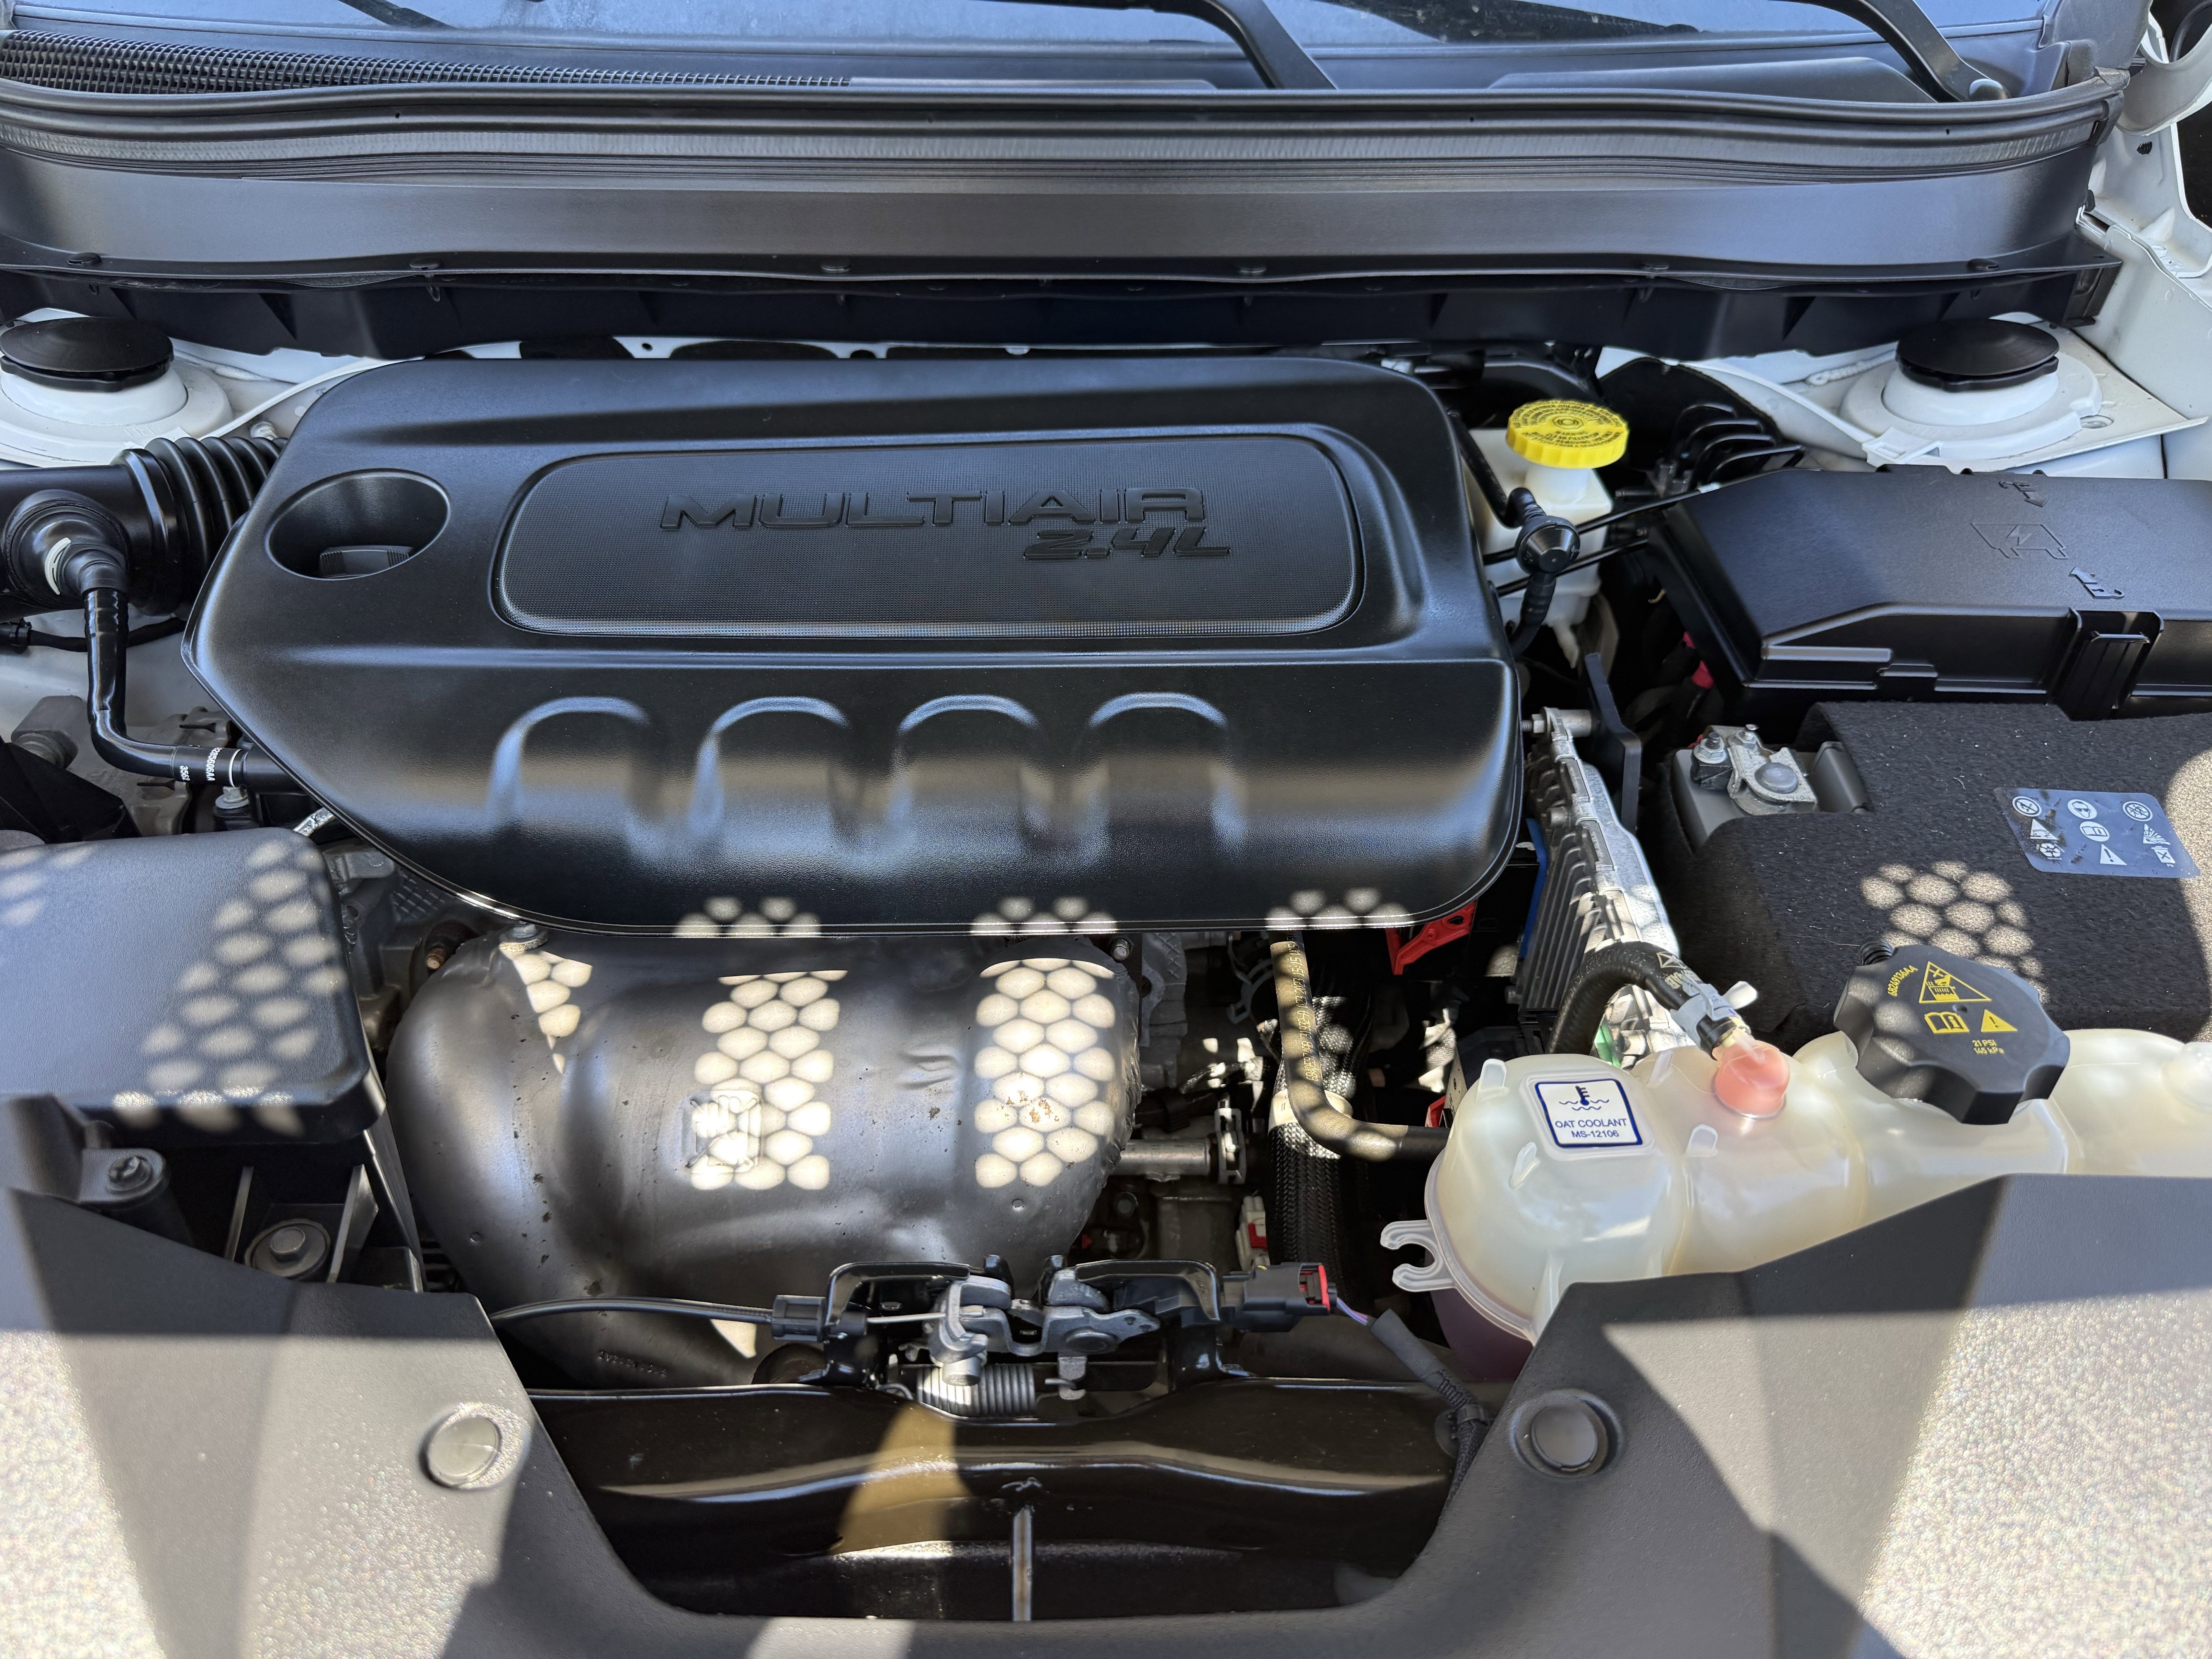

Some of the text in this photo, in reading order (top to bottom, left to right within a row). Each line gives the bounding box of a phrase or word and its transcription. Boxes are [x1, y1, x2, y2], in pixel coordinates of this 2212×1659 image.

[661, 488, 1207, 529] MULTIAIR
[1023, 526, 1230, 560] 2.4L
[180, 765, 191, 781] 3562
[1290, 957, 1304, 976] 15:15
[1293, 977, 1306, 995] 2023
[1555, 1118, 1627, 1128] OAT COOLANT
